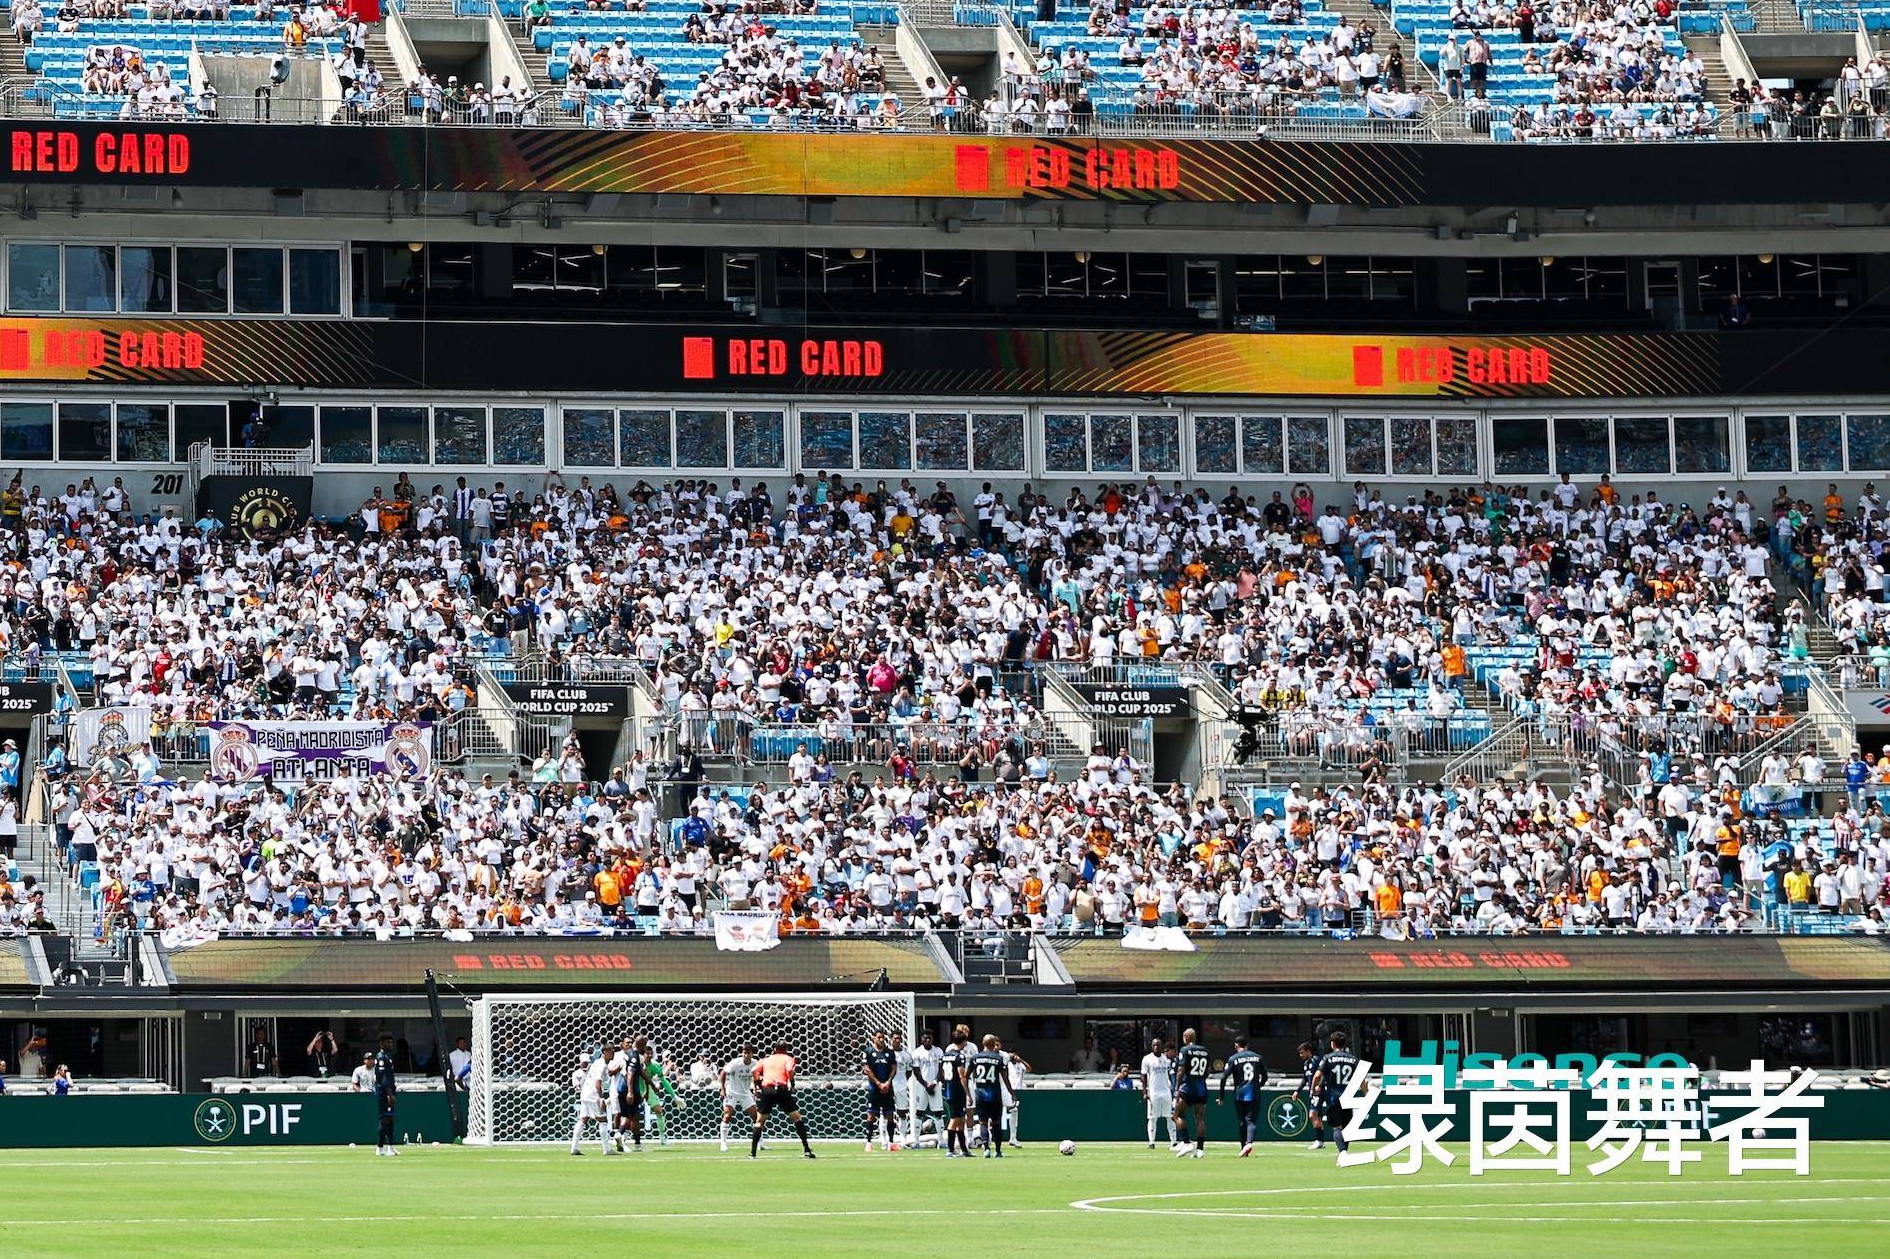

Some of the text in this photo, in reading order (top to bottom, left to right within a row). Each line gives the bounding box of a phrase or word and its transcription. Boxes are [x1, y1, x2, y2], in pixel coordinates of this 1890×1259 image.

[12, 131, 189, 174] RED CARD
[1005, 146, 1179, 189] RED CARD
[45, 330, 204, 369] RED CARD
[730, 340, 884, 376] RED CARD
[1397, 347, 1550, 384] RED CARD
[151, 475, 184, 494] 201
[239, 487, 279, 503] WORLD
[530, 689, 587, 699] FIFA CLUB
[1094, 691, 1151, 701] FIFA CLUB
[554, 701, 578, 712] CUP
[1118, 704, 1142, 714] CUP
[257, 726, 387, 750] PEÑA MADRIDISTA
[488, 954, 632, 970] RED CARD
[976, 1065, 996, 1083] 24
[1190, 1057, 1208, 1076] 29
[1242, 1062, 1255, 1081] 8
[1332, 1064, 1353, 1085] 12
[242, 1103, 302, 1135] PIF
